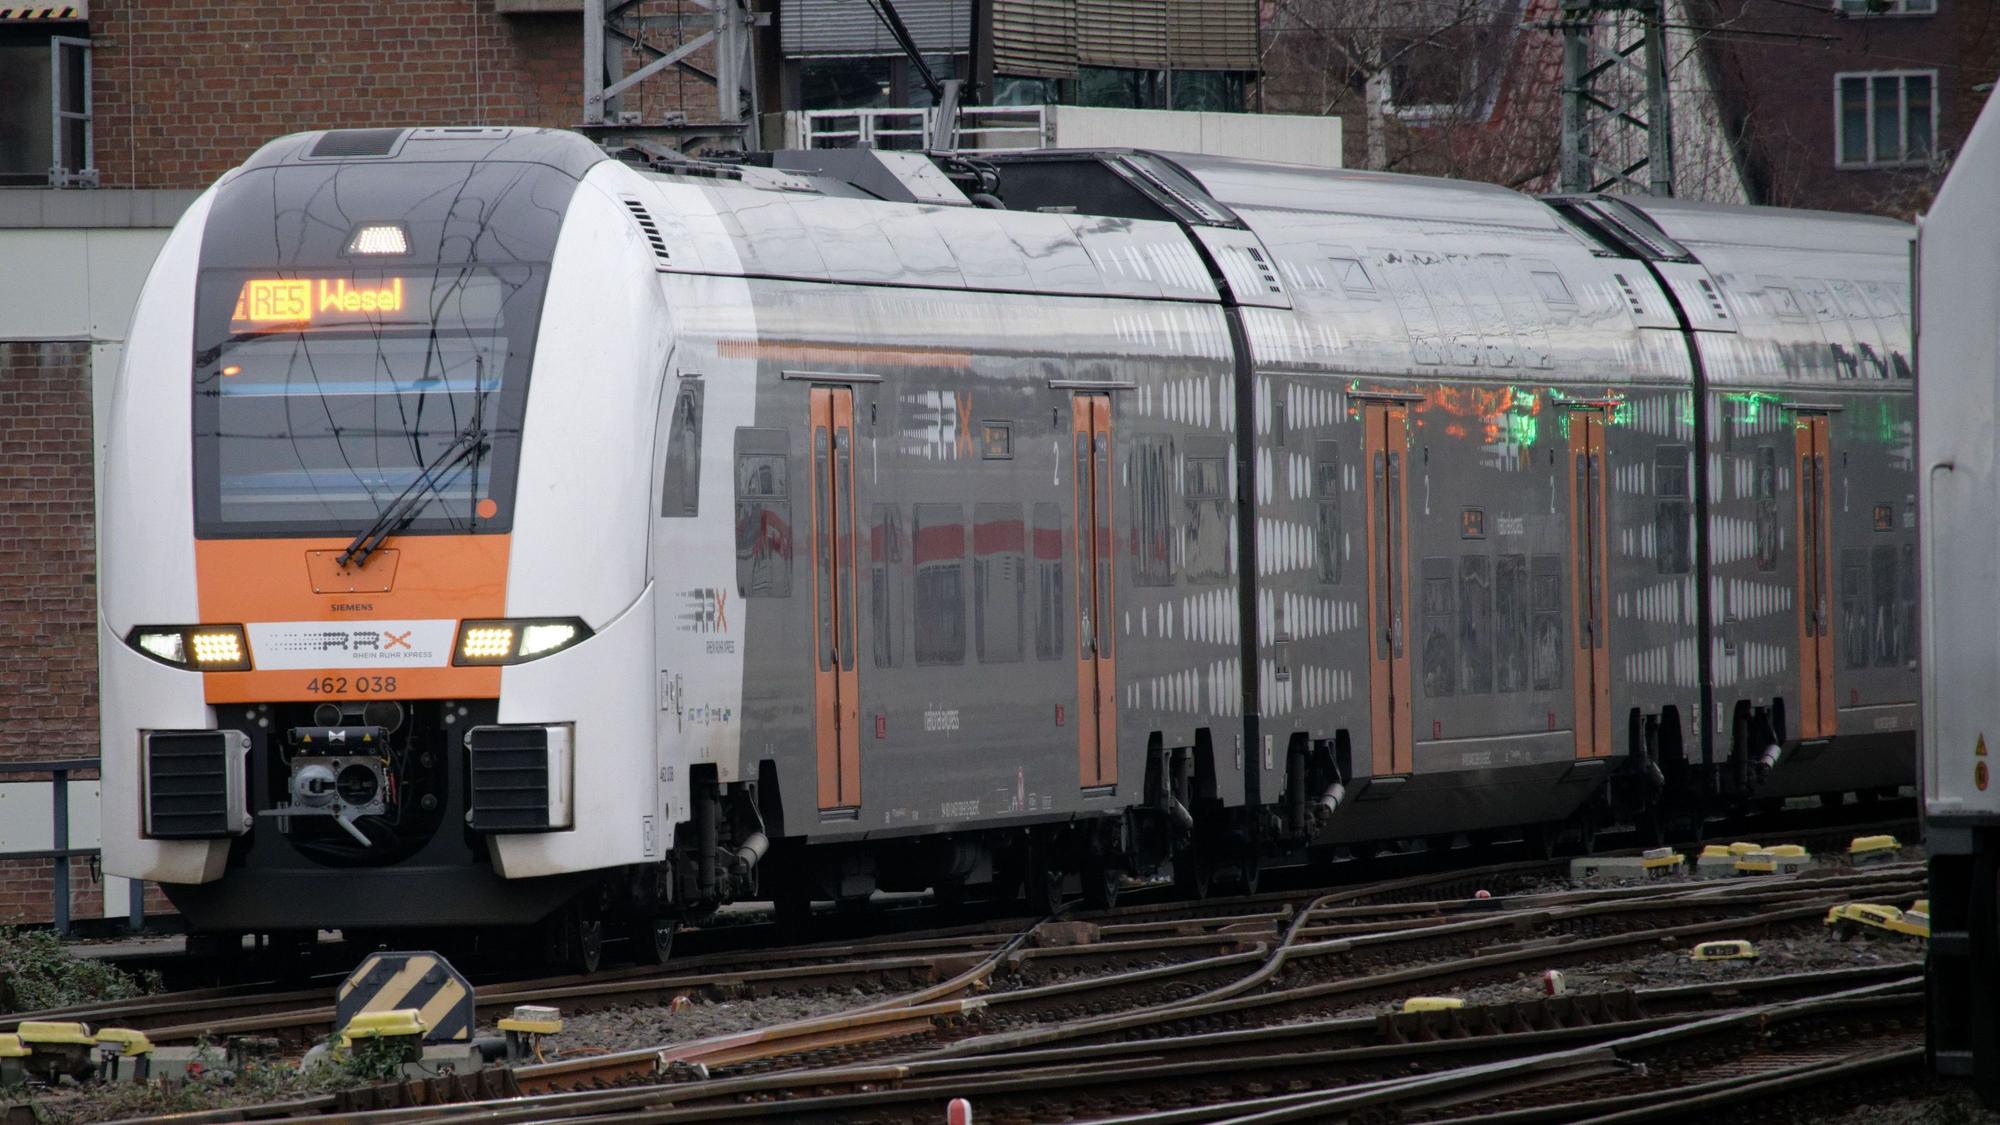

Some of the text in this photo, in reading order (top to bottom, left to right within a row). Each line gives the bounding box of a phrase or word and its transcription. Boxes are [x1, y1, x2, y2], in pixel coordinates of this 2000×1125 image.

[254, 278, 401, 317] RE5 Wesel
[1052, 440, 1060, 486] 2
[331, 604, 374, 612] SIEMENS
[315, 631, 412, 651] RRX
[306, 676, 397, 694] 462 038
